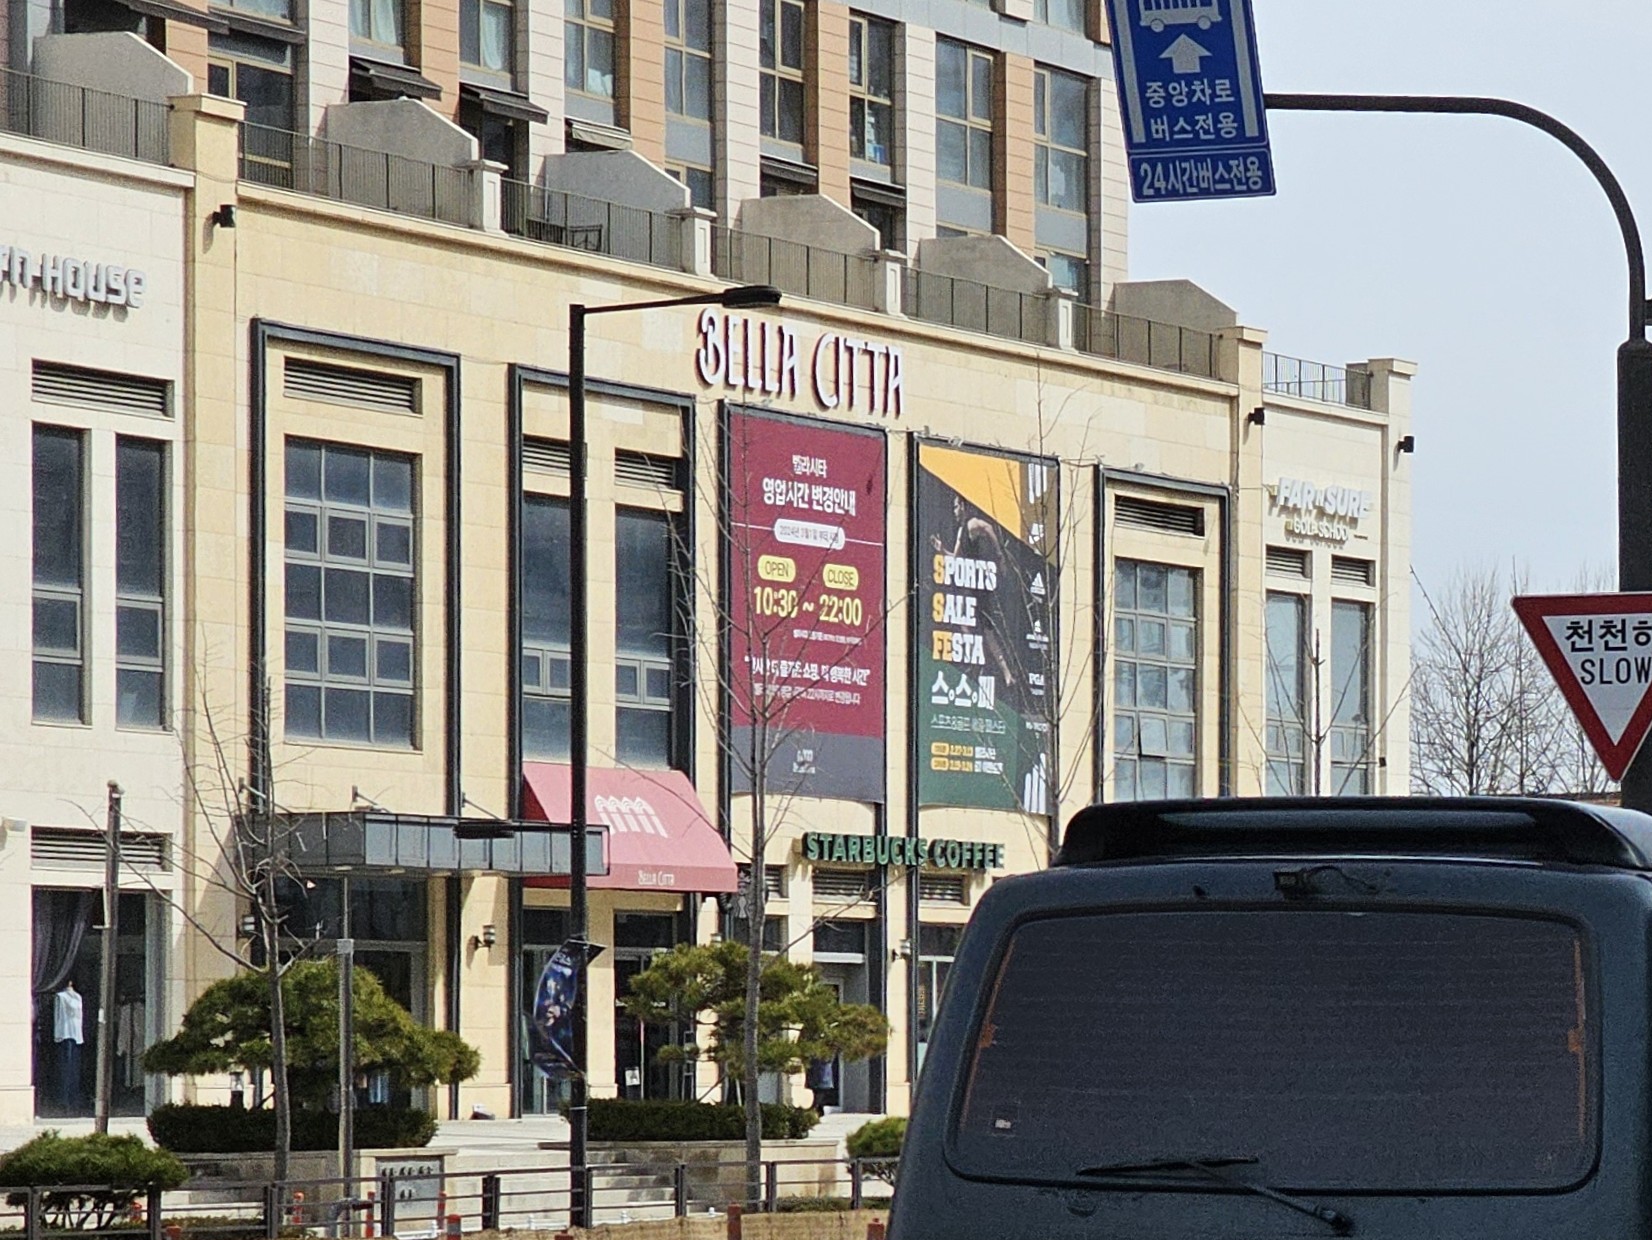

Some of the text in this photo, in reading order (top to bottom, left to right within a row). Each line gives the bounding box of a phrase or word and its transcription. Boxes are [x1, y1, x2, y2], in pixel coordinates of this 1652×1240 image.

[1145, 78, 1235, 108] 중앙차로
[1150, 112, 1239, 142] 버스전용
[1140, 156, 1263, 196] 24시간버스전용
[698, 306, 905, 416] BELLA CITTA
[762, 477, 856, 517] 영업시간 변경안내
[764, 561, 855, 586] OPEN CLOSE
[933, 554, 997, 591] SPORTS
[753, 586, 799, 618] 10:30
[819, 594, 863, 626] 22:00
[932, 592, 977, 627] SALE
[932, 630, 986, 665] FESTA
[1580, 656, 1652, 685] SLOW
[806, 832, 1005, 869] STARBUCKS COFFEE
